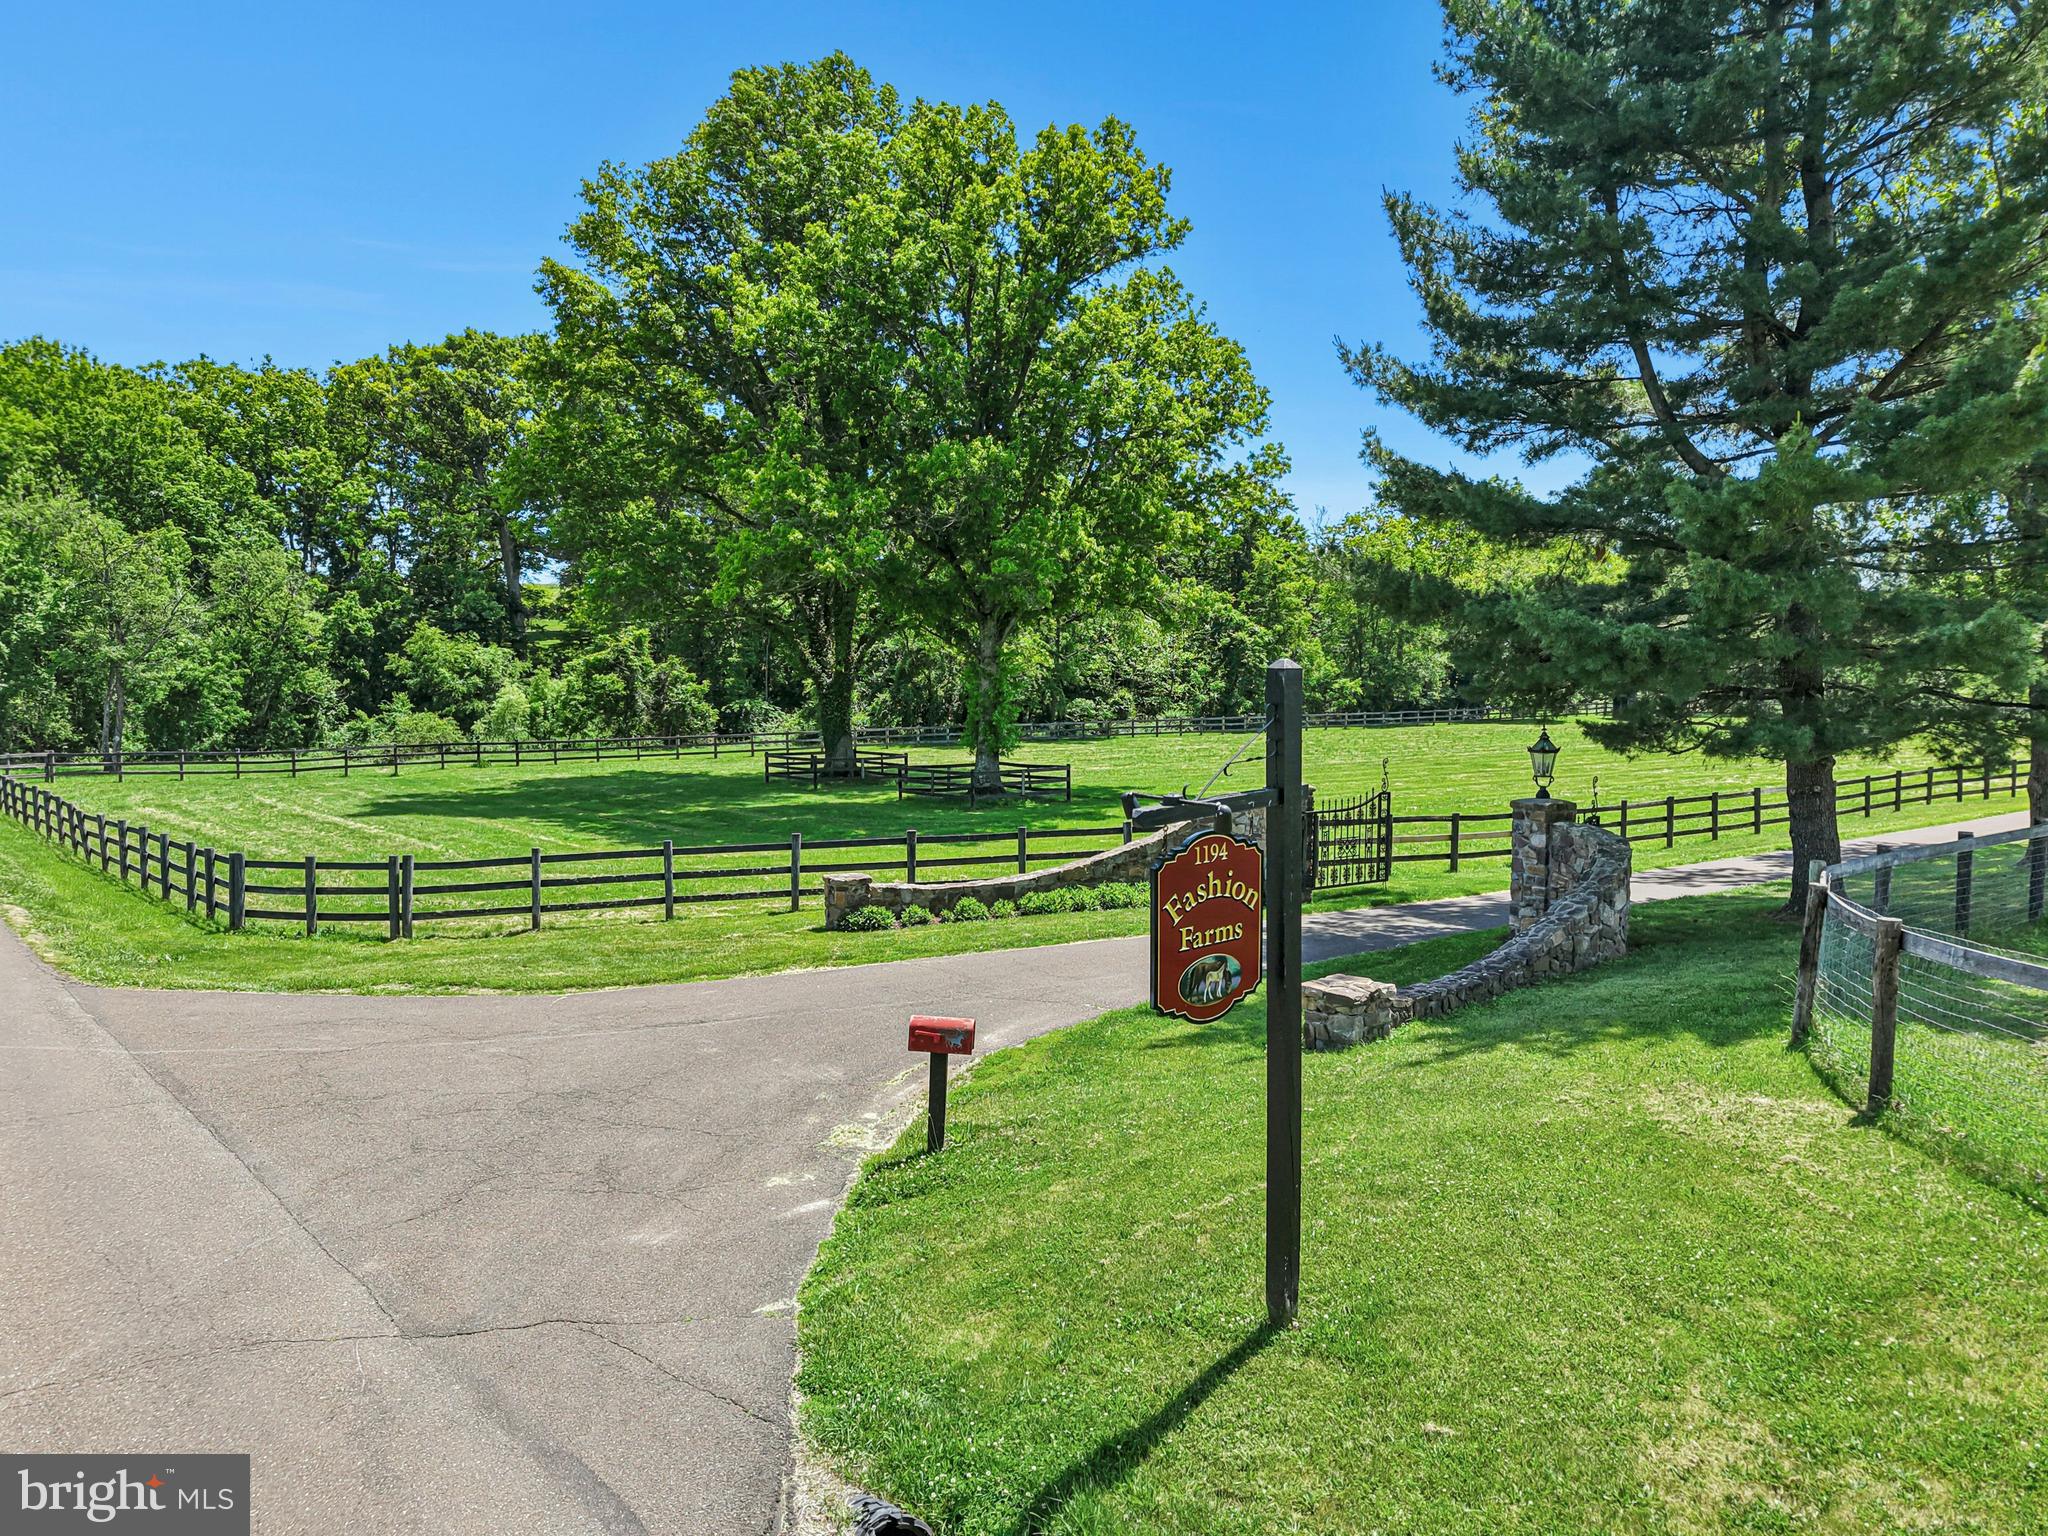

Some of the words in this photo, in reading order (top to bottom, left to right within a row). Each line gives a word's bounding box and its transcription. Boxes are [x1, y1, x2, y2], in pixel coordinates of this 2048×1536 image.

[1194, 842, 1229, 866] 1194
[1162, 870, 1260, 927] Fashion
[1178, 921, 1244, 952] Farms
